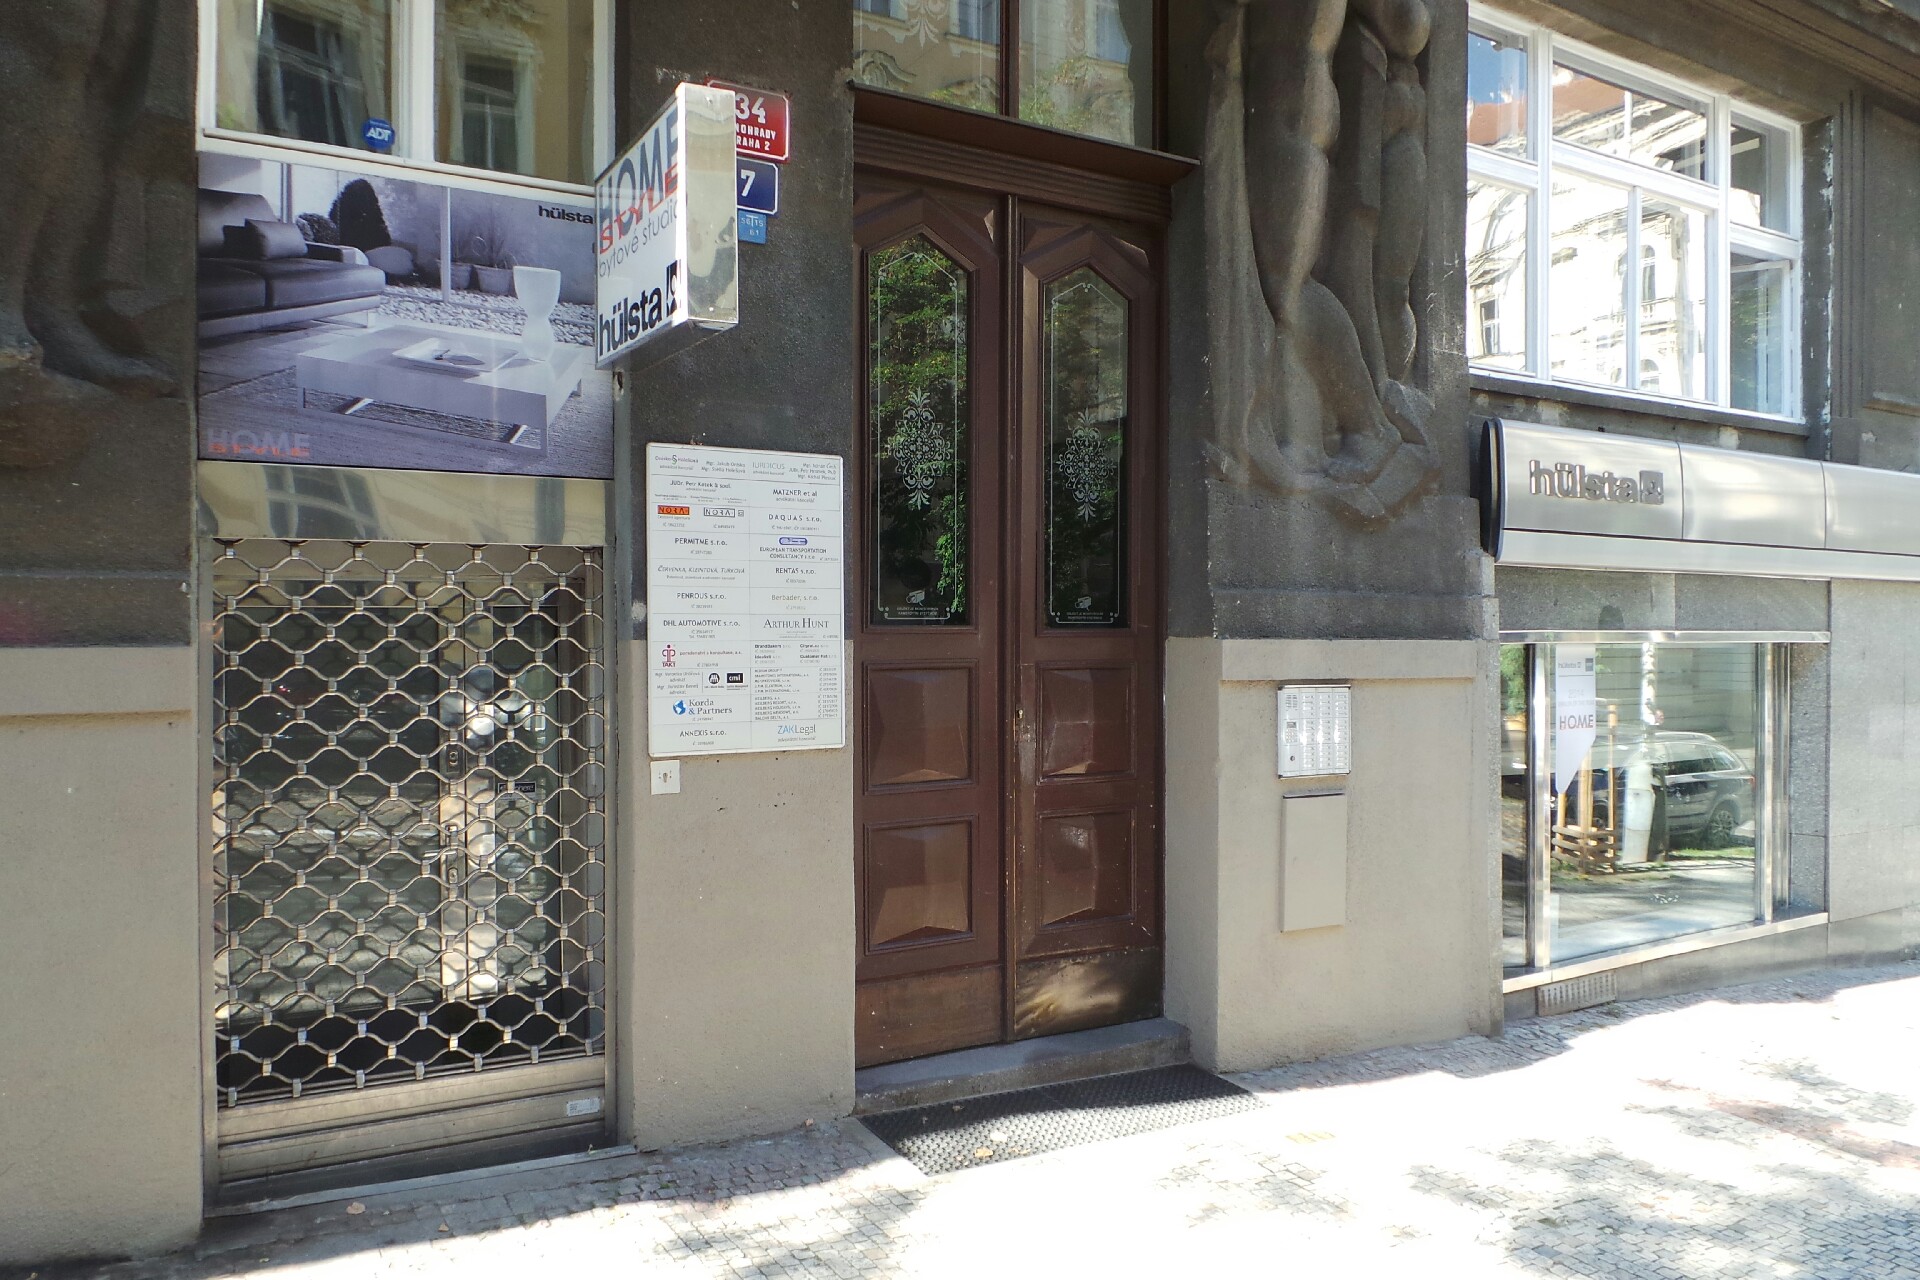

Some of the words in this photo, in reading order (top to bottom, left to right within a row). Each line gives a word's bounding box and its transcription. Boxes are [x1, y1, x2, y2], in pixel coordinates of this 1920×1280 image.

[735, 93, 766, 124] 34
[366, 127, 392, 142] ADT
[736, 135, 760, 149] RAHA
[764, 141, 770, 150] 2
[740, 169, 756, 197] 7
[538, 205, 594, 224] hülsta
[600, 163, 678, 254] STYLE
[599, 287, 662, 357] hülsta
[1529, 460, 1639, 503] hülsta
[663, 619, 676, 627] DHL
[678, 619, 722, 627] AUTOMOTIVE
[689, 698, 714, 707] Korda
[697, 706, 733, 715] Partners
[1559, 714, 1594, 731] HOME
